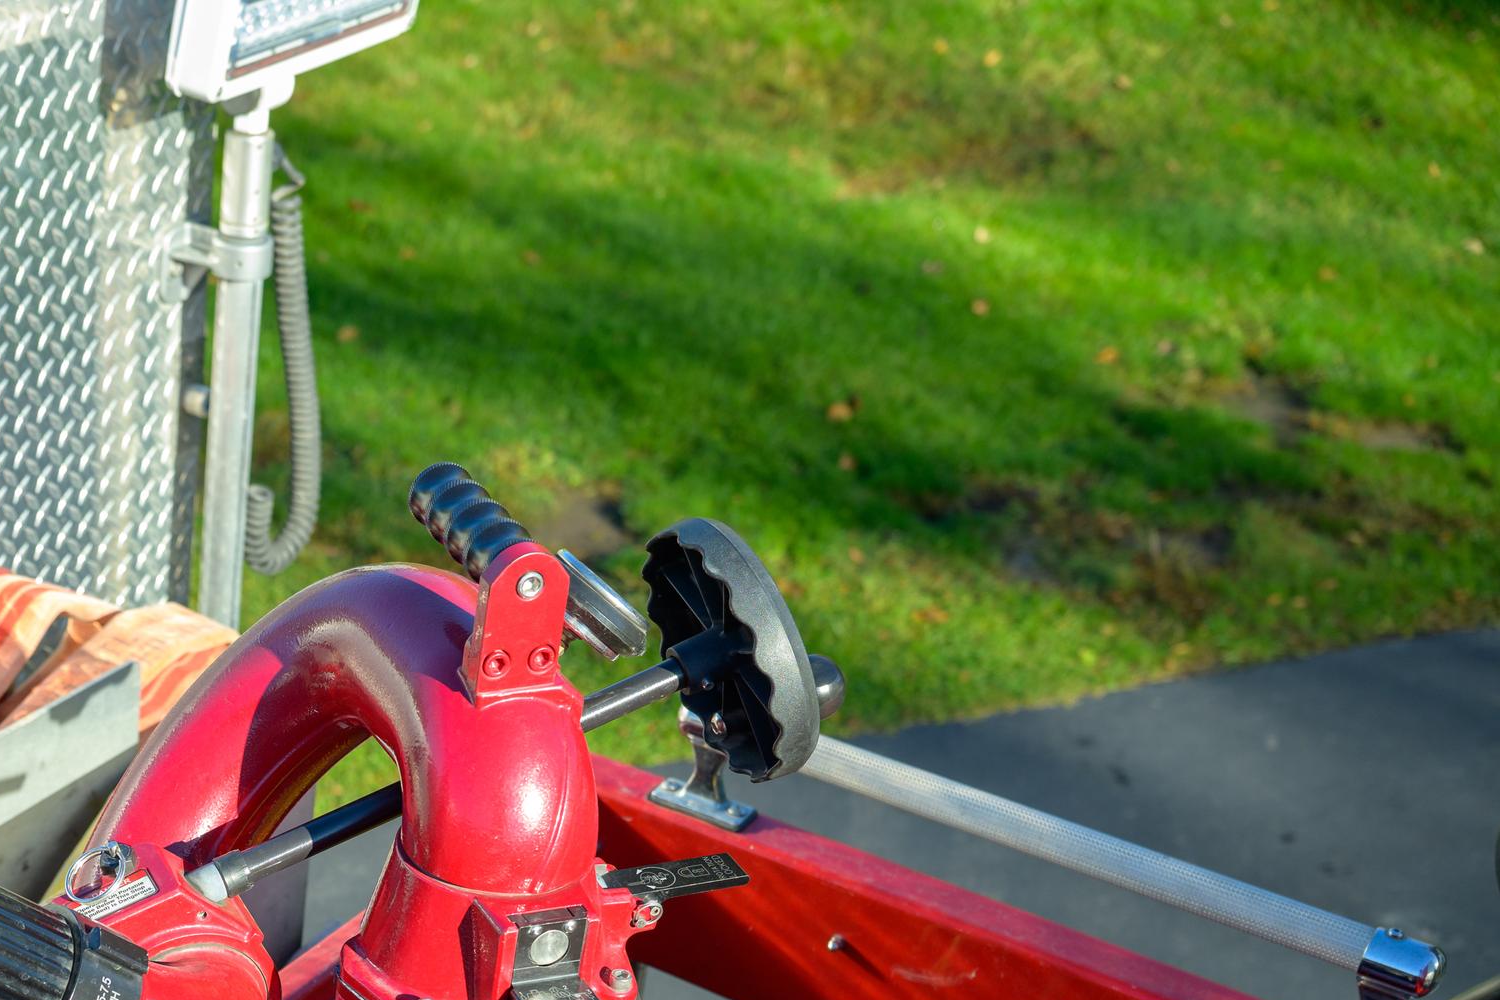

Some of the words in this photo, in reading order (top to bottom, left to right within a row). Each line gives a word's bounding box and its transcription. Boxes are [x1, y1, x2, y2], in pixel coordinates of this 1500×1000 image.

[117, 892, 130, 900] This
[131, 885, 146, 896] Stop
[118, 881, 144, 895] Portable
